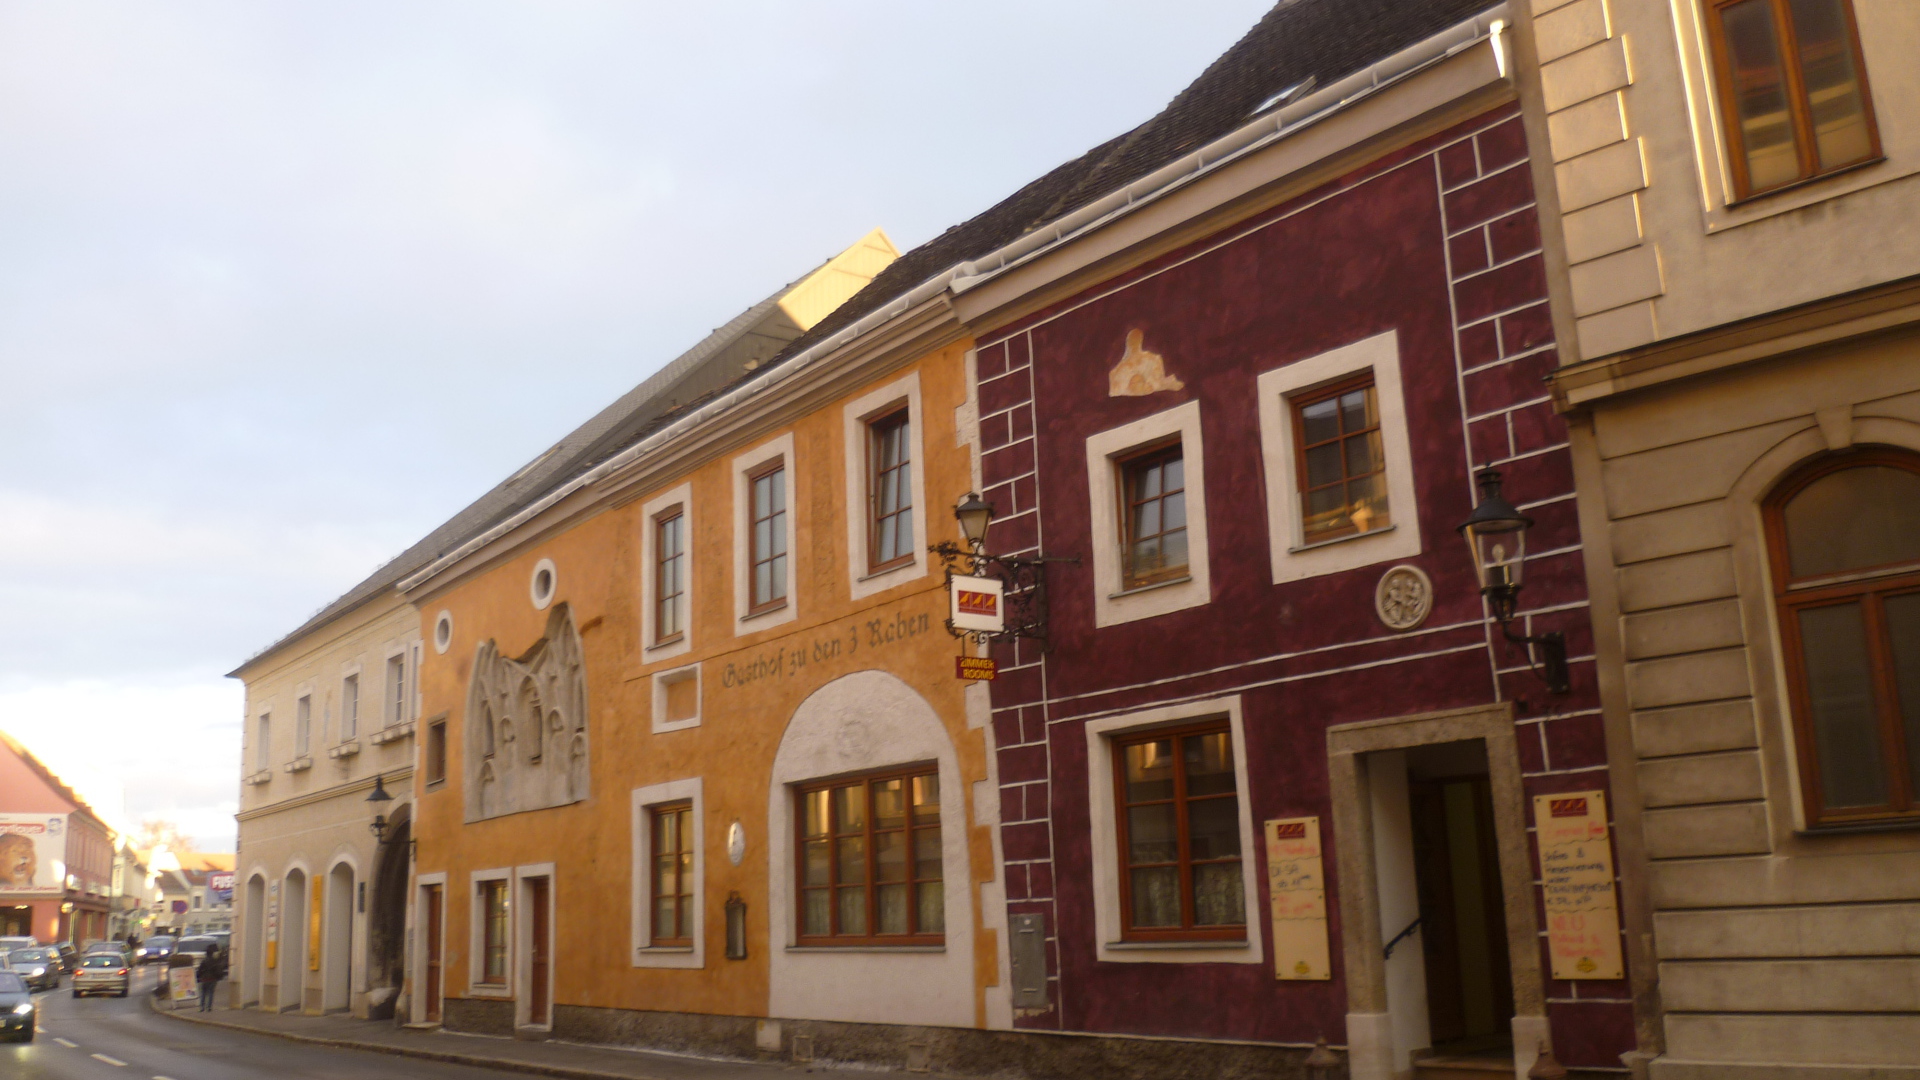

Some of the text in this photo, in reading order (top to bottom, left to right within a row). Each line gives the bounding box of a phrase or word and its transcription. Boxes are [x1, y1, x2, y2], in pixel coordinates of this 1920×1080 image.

[722, 611, 930, 688] Gasthof zu den 3 Raben
[959, 657, 995, 669] ZIMMER
[963, 668, 995, 680] ROOMS
